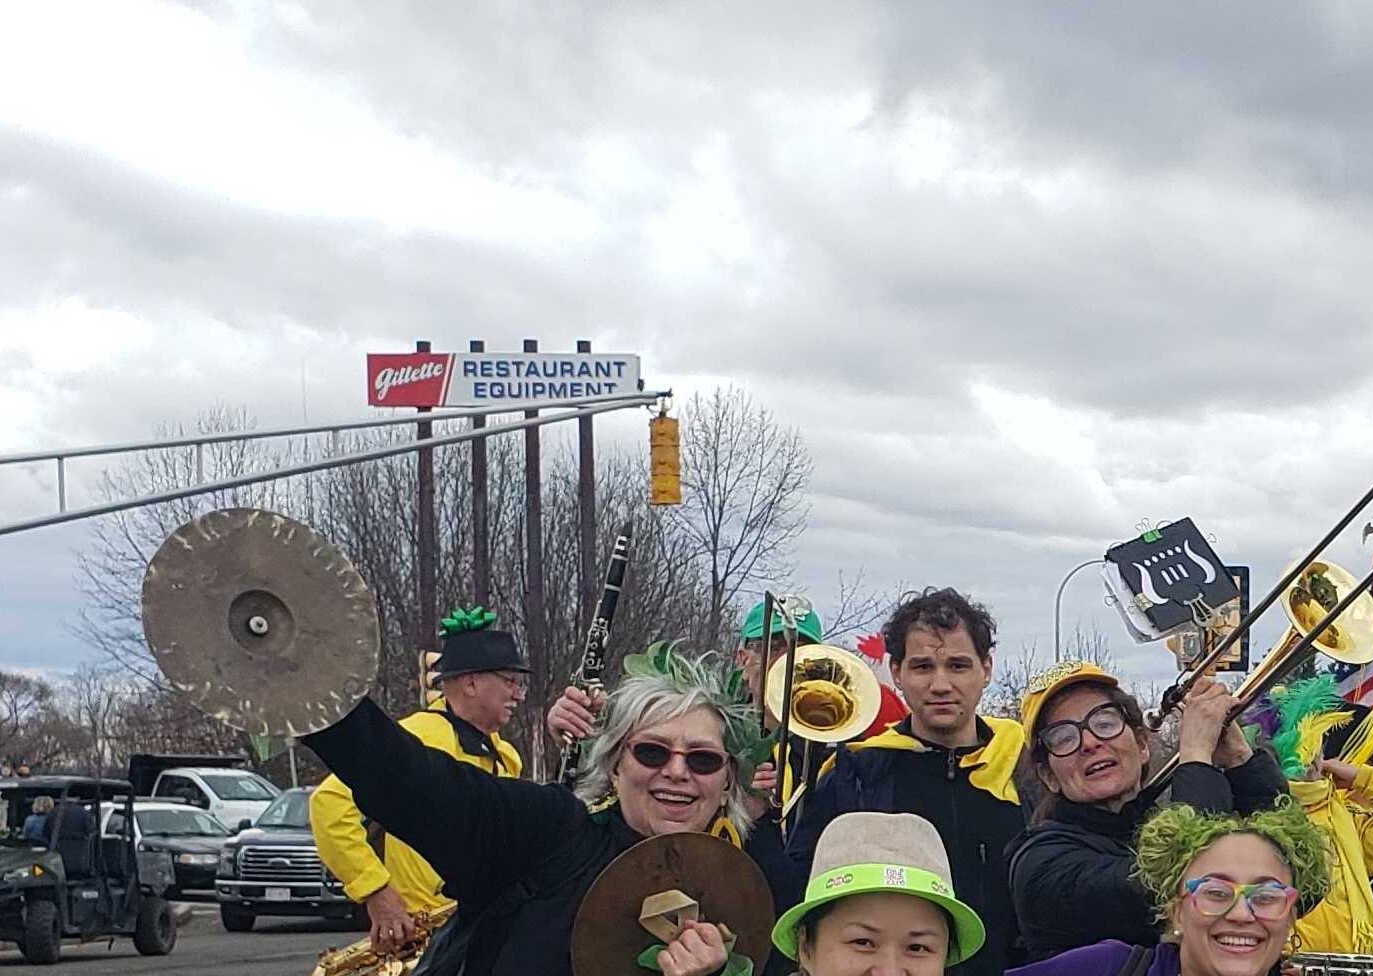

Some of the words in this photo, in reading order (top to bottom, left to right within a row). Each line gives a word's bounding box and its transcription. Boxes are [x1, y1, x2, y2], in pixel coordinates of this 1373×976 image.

[463, 360, 627, 378] RESTAURANT
[375, 362, 444, 400] Gillette
[473, 382, 618, 399] EQUIPMENT
